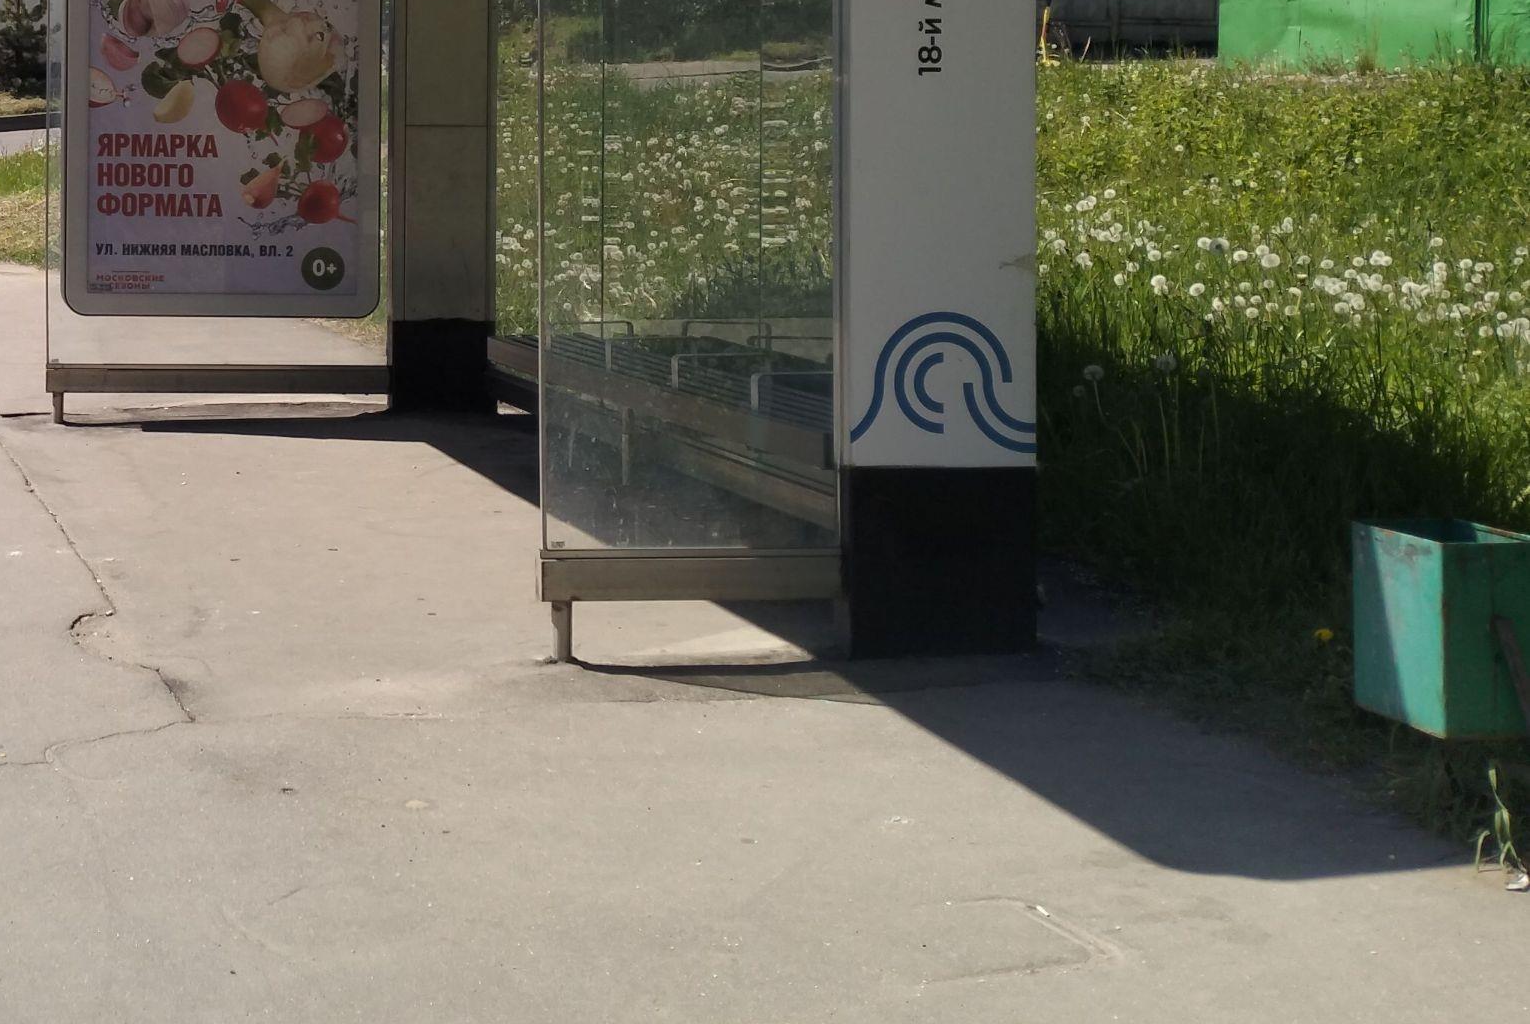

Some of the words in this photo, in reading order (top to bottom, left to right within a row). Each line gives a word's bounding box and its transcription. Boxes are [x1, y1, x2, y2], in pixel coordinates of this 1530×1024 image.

[918, 18, 943, 76] 18-й
[97, 133, 219, 158] ЯРМАРКА
[97, 163, 194, 188] НОВОГО
[96, 192, 223, 217] ФОРМАТА
[95, 243, 117, 256] УЛ.
[122, 243, 177, 257] НИЖНЯЯ
[180, 244, 255, 258] МАСЛОВКА,
[259, 244, 282, 257] ВЛ.
[286, 245, 294, 257] 2
[312, 259, 338, 277] 0+
